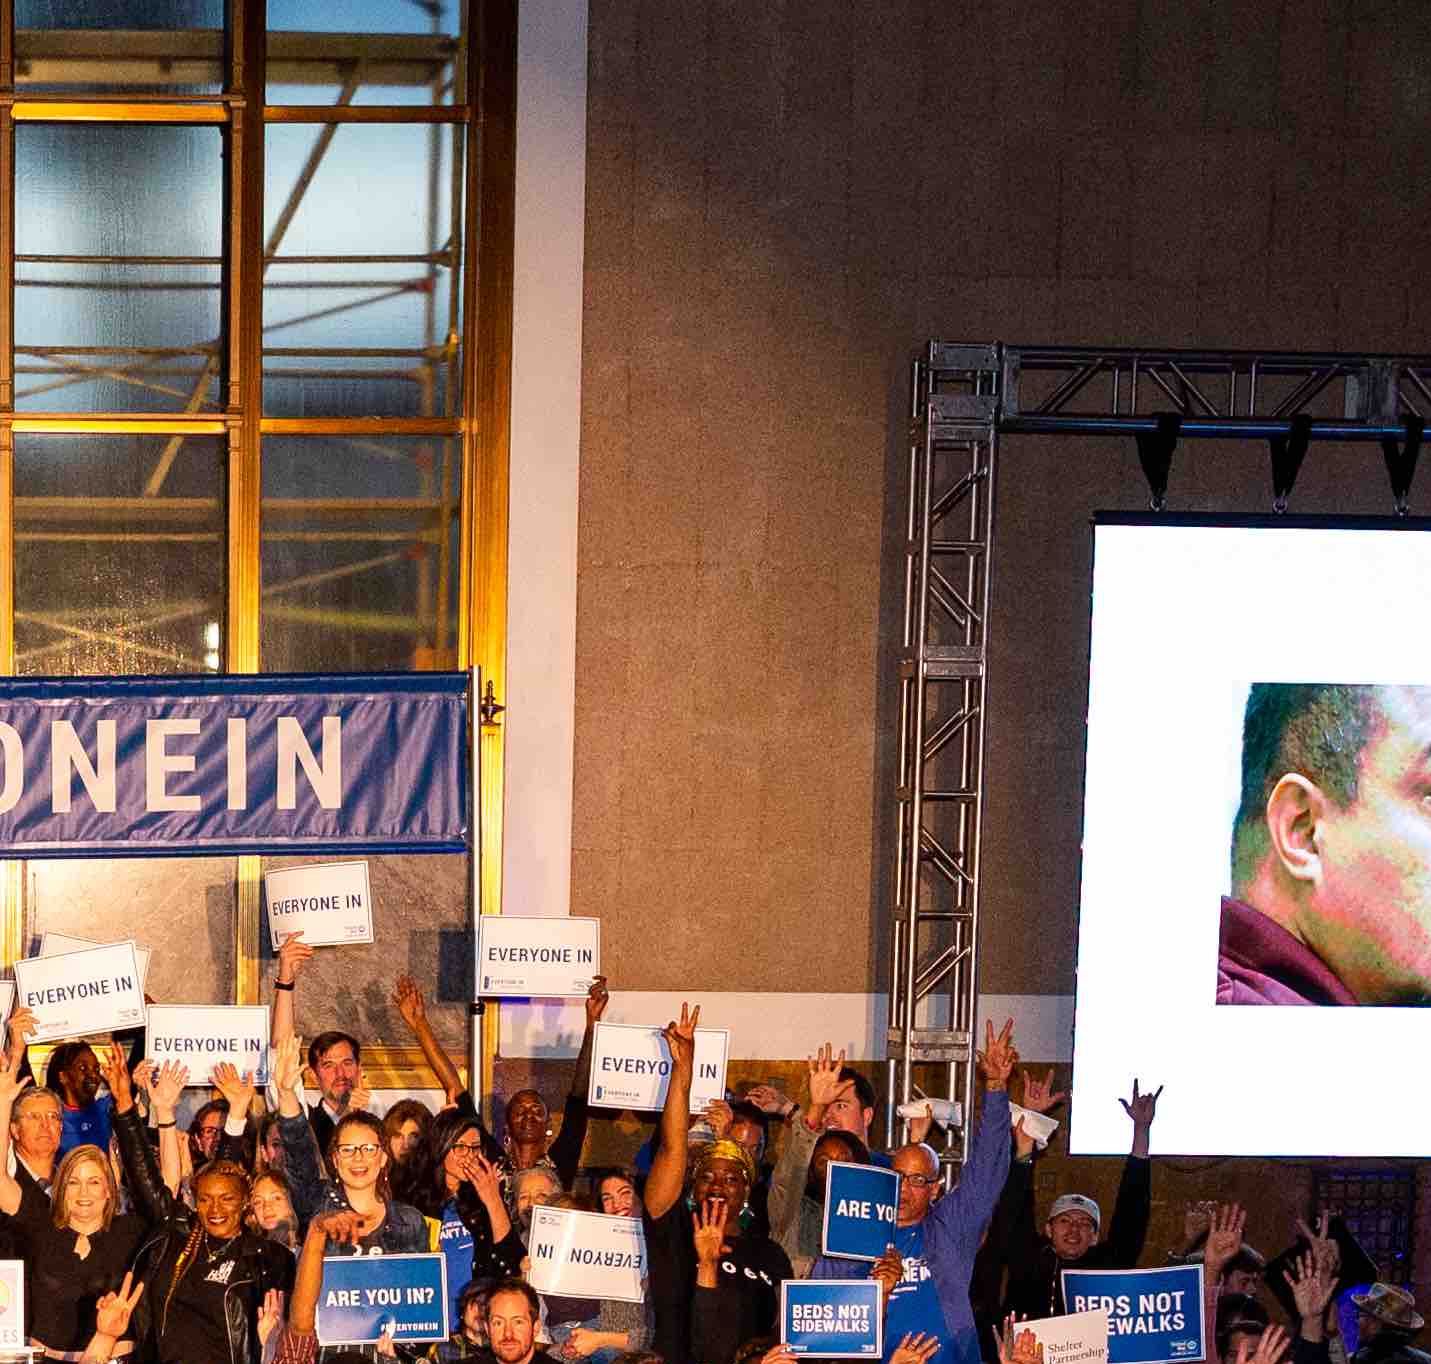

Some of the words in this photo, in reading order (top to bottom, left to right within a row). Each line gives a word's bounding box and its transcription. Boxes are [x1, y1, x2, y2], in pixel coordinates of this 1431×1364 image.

[273, 896, 341, 917] EVERYONE
[345, 894, 361, 909] IN
[488, 948, 571, 963] EVERYONE
[577, 948, 592, 963] IN
[27, 980, 110, 1007] EVERYONE
[114, 975, 133, 993] IN
[154, 1037, 238, 1053] EVERYONE
[244, 1037, 261, 1053] IN
[602, 1057, 669, 1077] EVERYO
[700, 1063, 717, 1079] IN
[837, 1199, 870, 1219] ARE
[876, 1204, 896, 1223] YO
[536, 1243, 553, 1259] IN
[326, 1290, 361, 1307] ARE
[365, 1288, 401, 1306] YOU
[406, 1287, 434, 1304] IN?
[1139, 1290, 1185, 1314] NOT
[792, 1304, 834, 1320] BEDS
[839, 1304, 870, 1320] NOT
[792, 1319, 870, 1332] SIDEWALKS
[1107, 1313, 1185, 1336] EWALKS
[1048, 1341, 1083, 1354] Shelter
